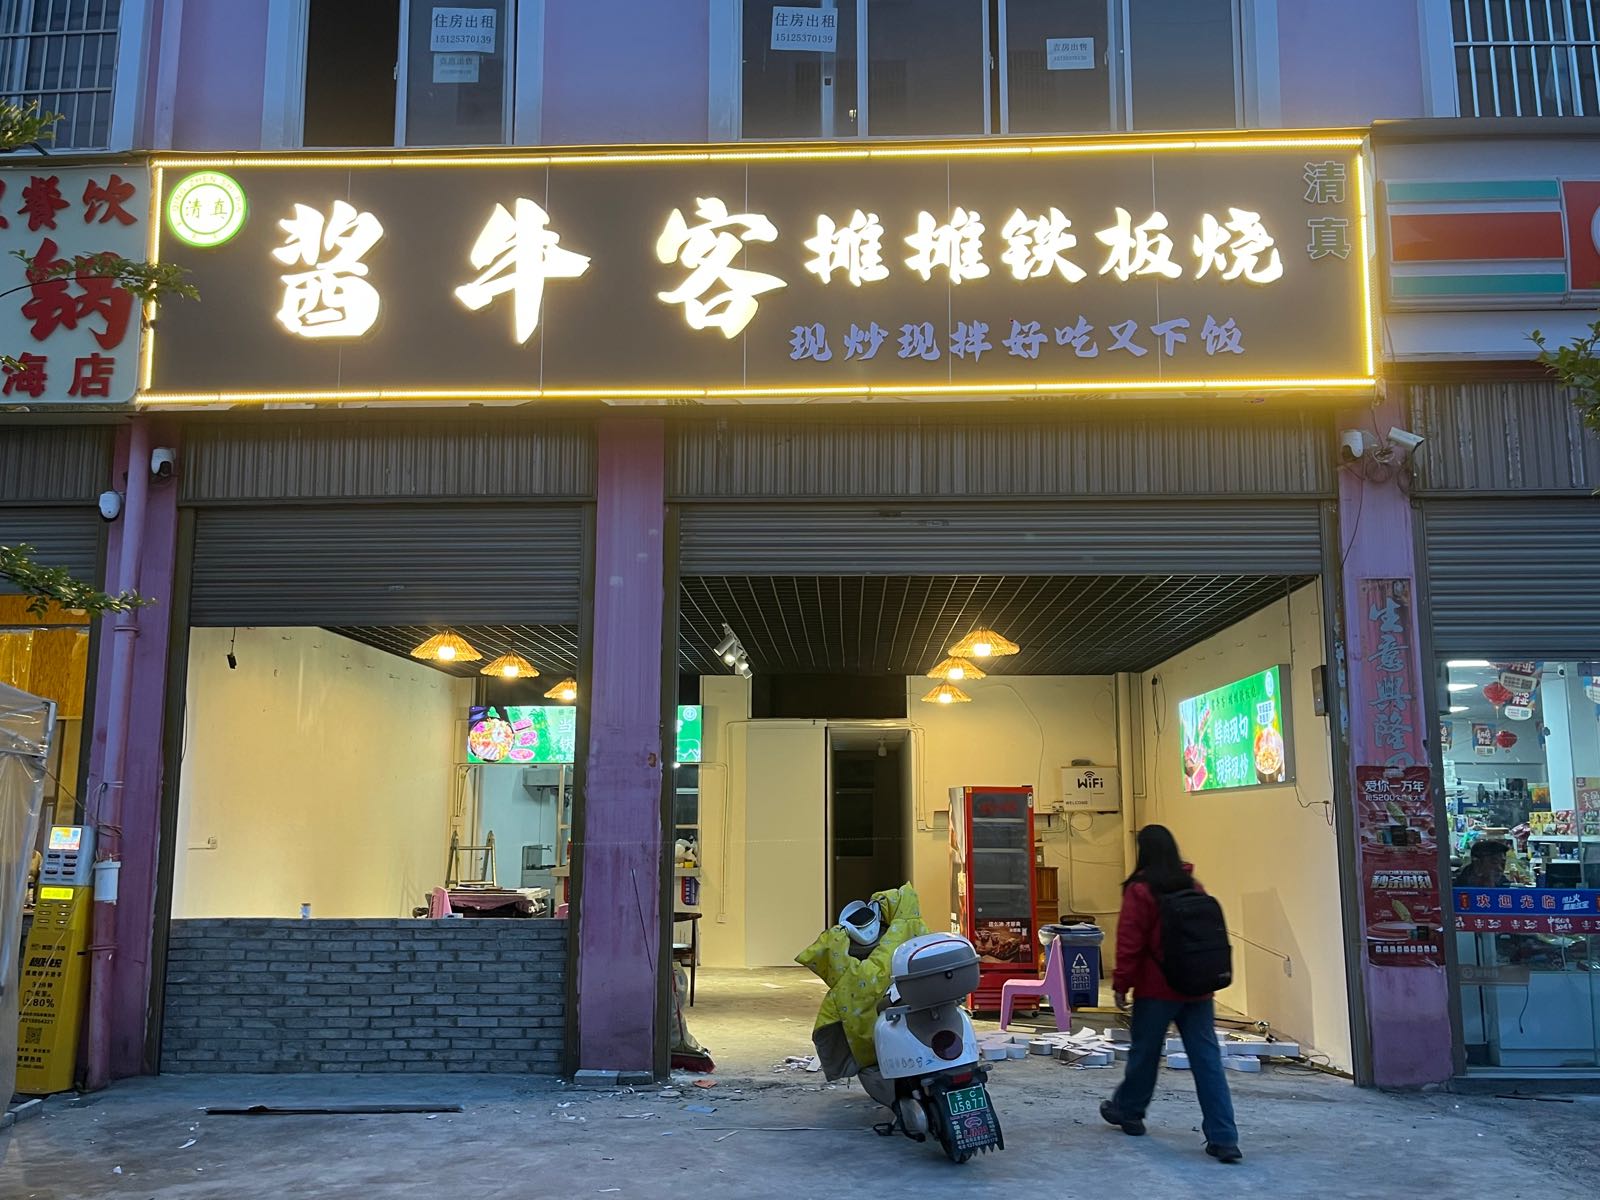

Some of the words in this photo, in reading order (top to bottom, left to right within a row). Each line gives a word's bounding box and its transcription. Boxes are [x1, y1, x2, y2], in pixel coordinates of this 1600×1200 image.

[434, 14, 494, 29] 住房出租
[775, 12, 836, 28] 住房出租
[435, 34, 492, 44] 15125370139
[776, 33, 833, 43] 15125370139
[0, 174, 138, 232] 餐饮
[185, 198, 228, 220] 清真
[1303, 161, 1351, 260] 清真
[789, 314, 1247, 362] 现炒现拌好吃又下饭
[2, 352, 116, 398] 海店
[1365, 780, 1425, 793] 爱你一万年
[1370, 875, 1433, 888] 秒杀时刻
[1476, 894, 1556, 909] 欢迎光临
[969, 1090, 977, 1098] C
[953, 1096, 984, 1113] J5877
